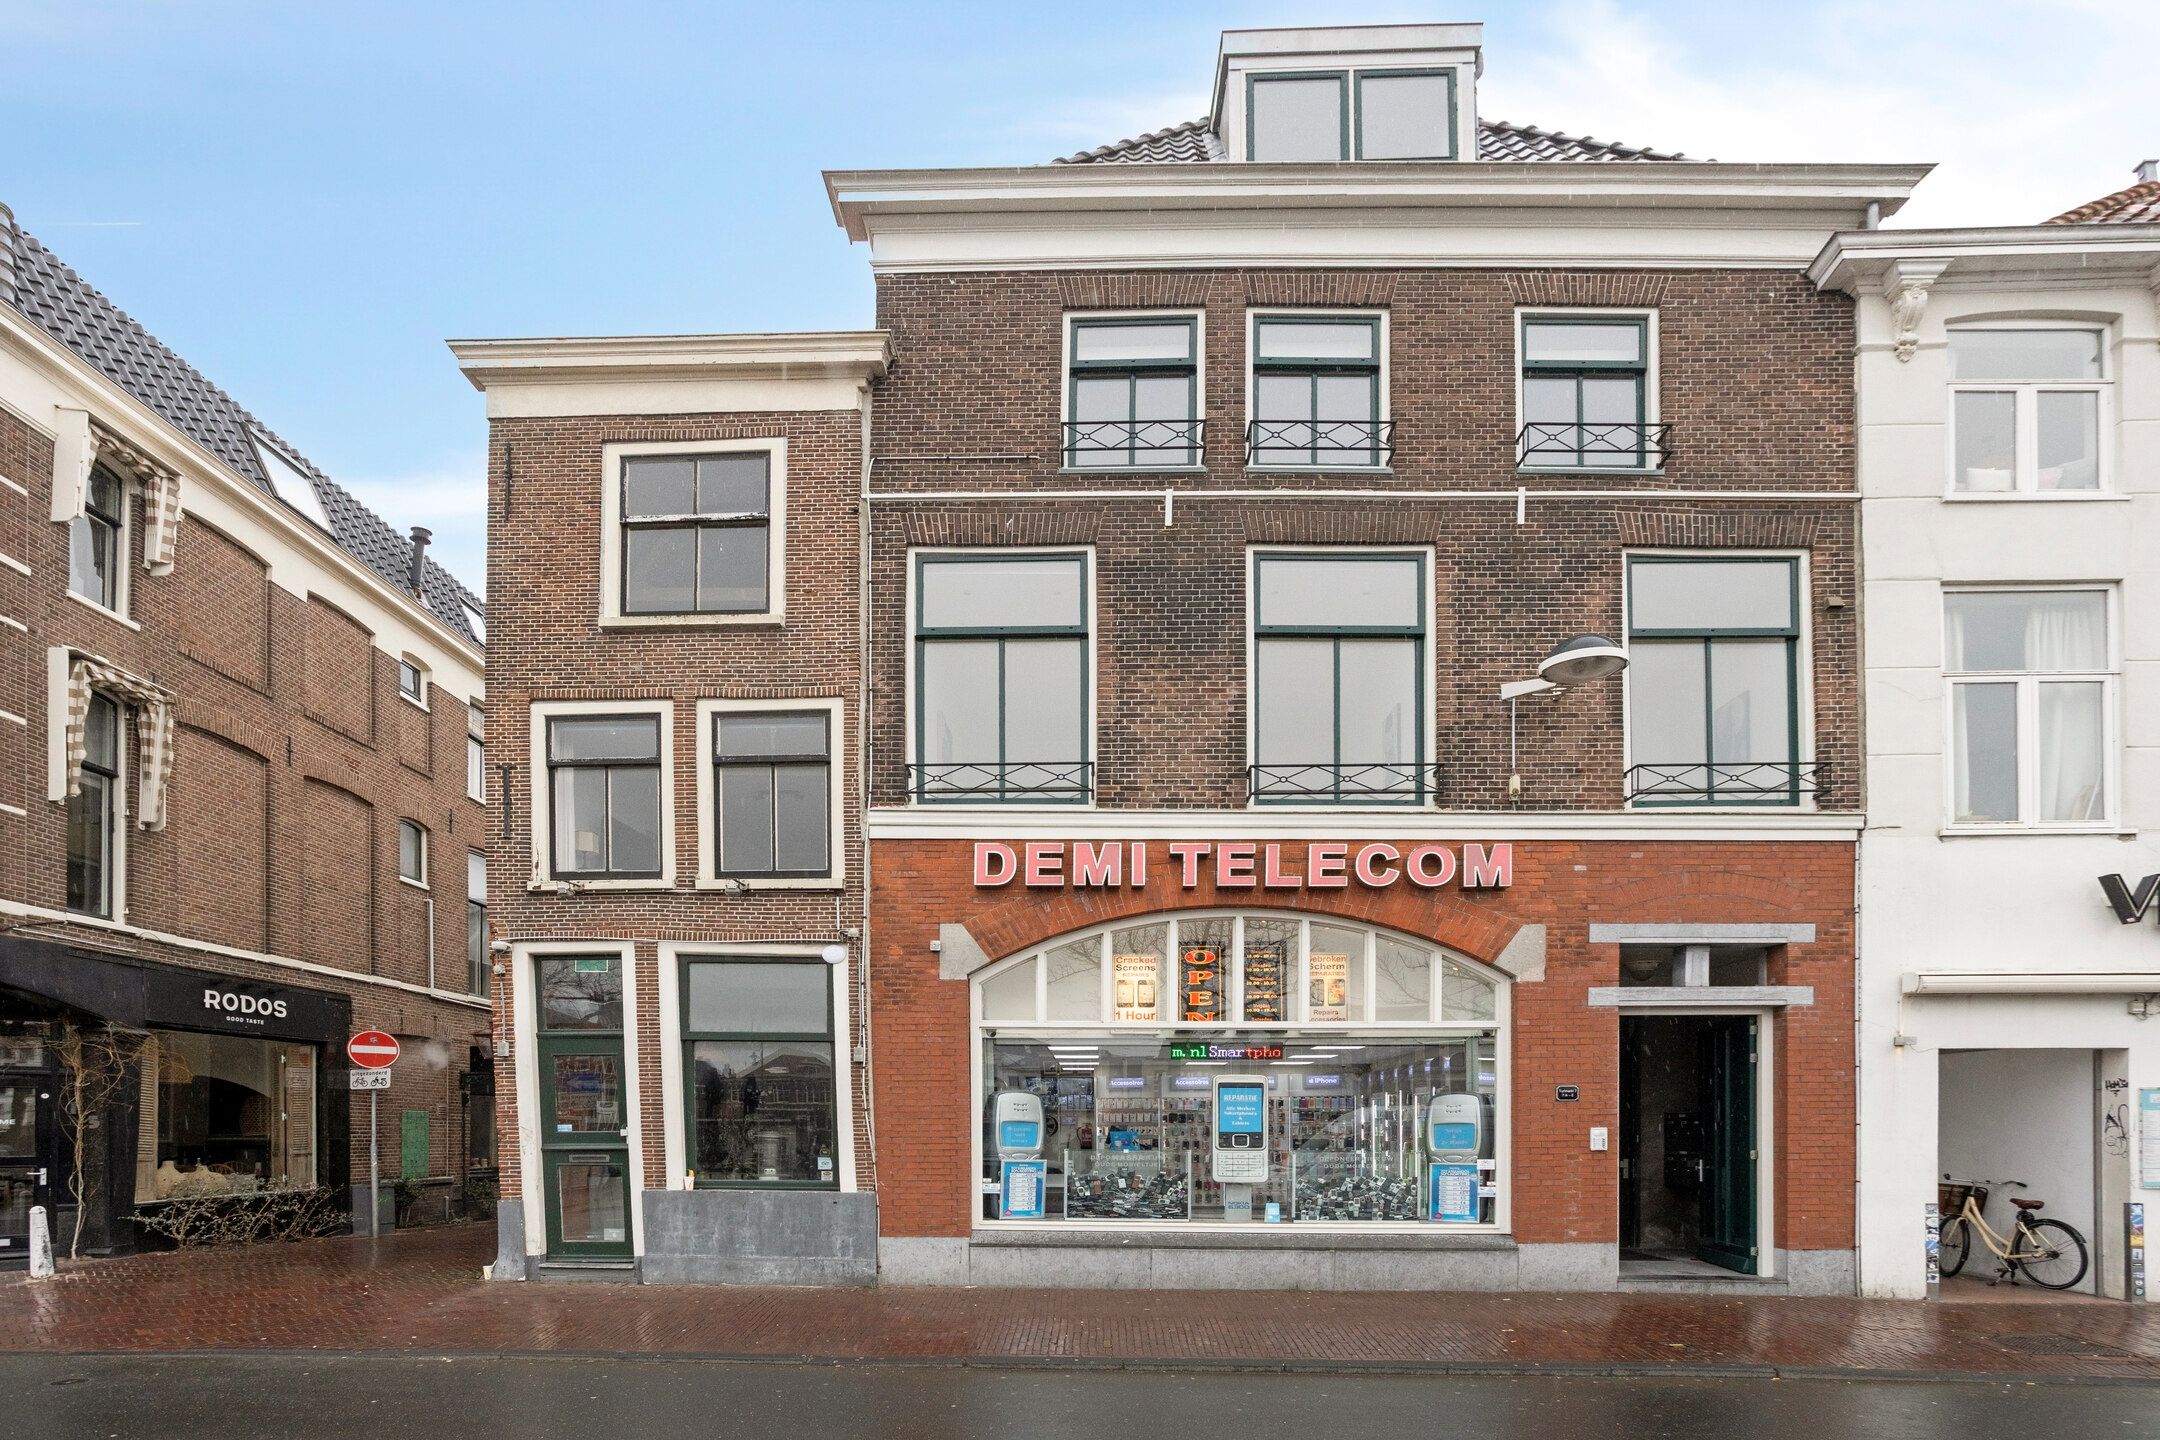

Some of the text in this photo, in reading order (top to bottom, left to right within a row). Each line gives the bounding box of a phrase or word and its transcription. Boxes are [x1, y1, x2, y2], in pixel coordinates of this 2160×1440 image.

[974, 842, 1513, 888] DEMI TELECOM
[1115, 956, 1156, 964] Cracked
[1115, 964, 1156, 972] Screens
[1184, 949, 1217, 1021] OPEN
[203, 989, 288, 1018] RODOS
[226, 1015, 244, 1023] GOOD
[1115, 1011, 1156, 1020] 1 Hour
